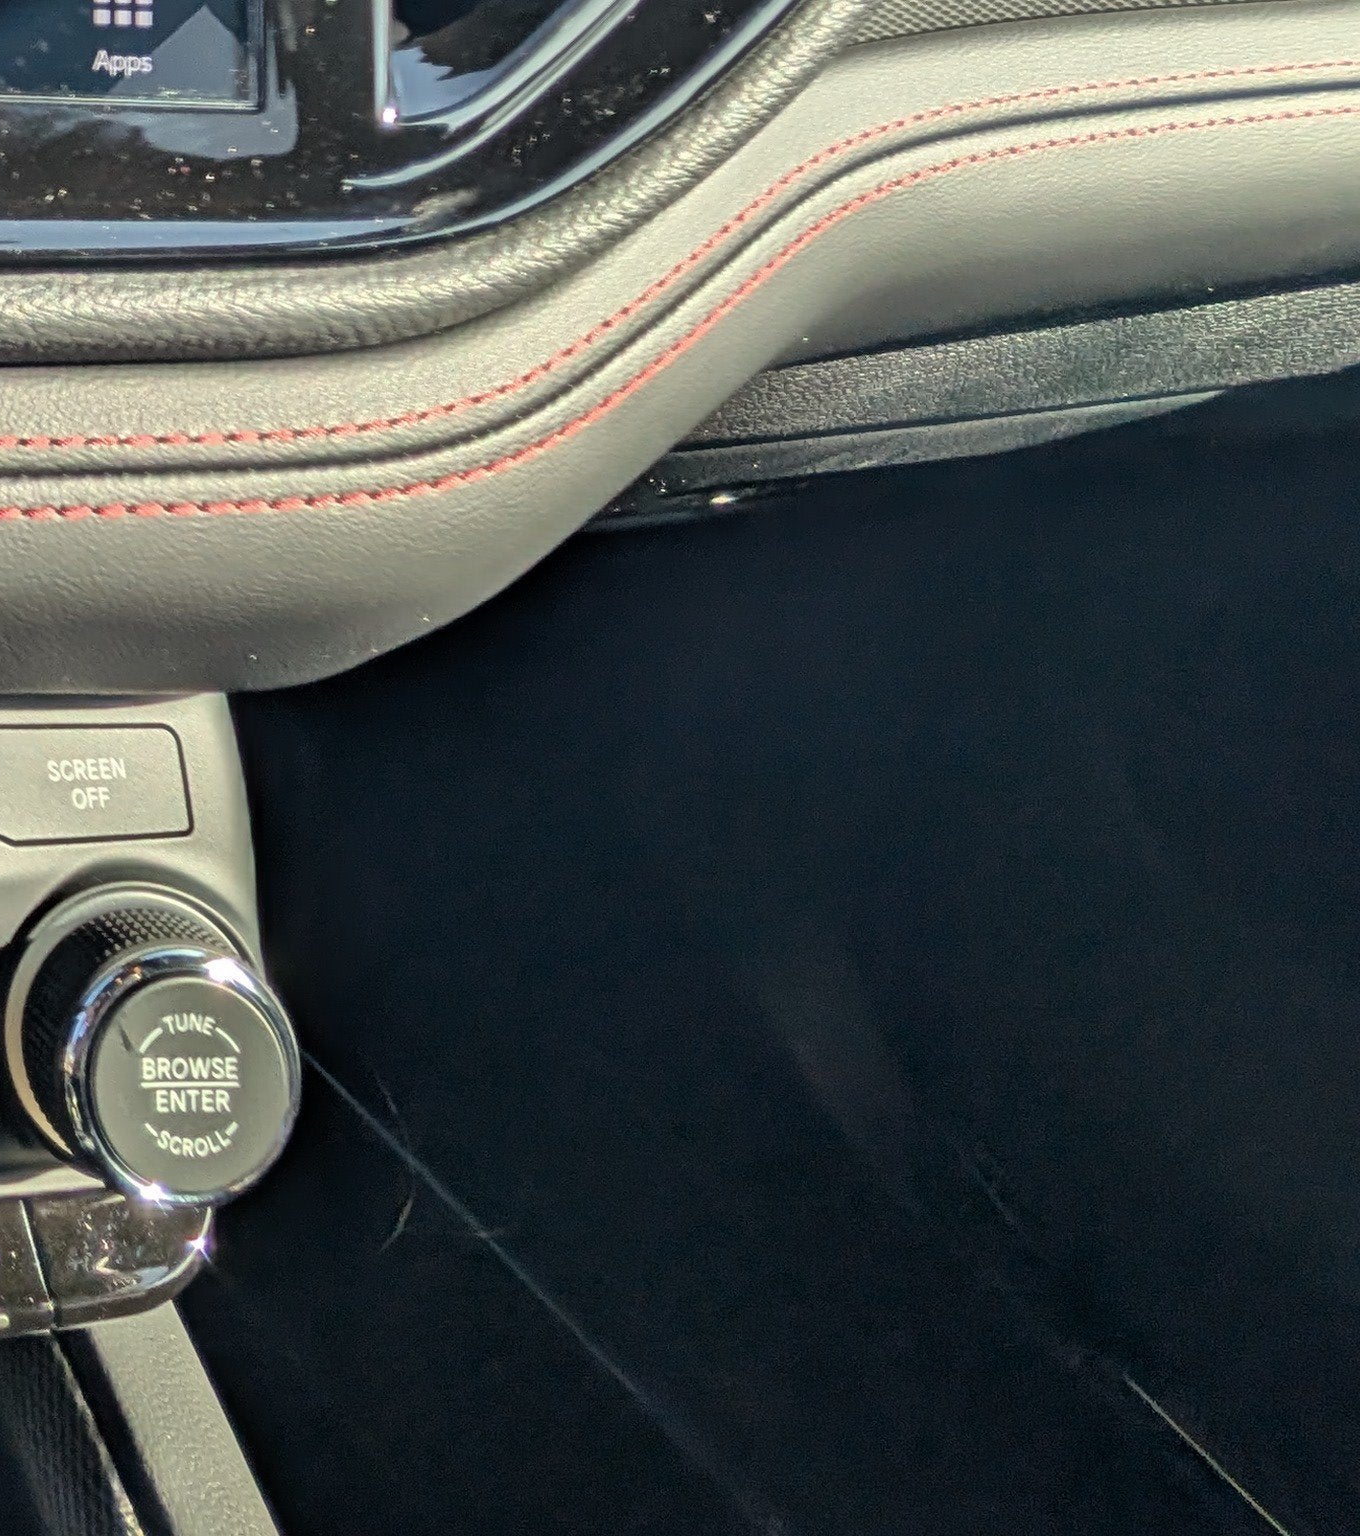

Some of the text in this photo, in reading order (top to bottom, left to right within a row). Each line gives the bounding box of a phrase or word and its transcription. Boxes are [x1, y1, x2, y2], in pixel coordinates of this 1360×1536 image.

[92, 48, 154, 77] Apps
[47, 755, 128, 784] SCREEN
[70, 784, 111, 810] OFF
[161, 1013, 217, 1036] TUNE
[141, 1056, 239, 1080] BROWSE
[155, 1090, 231, 1114] ENTER
[156, 1129, 231, 1158] SCROLL
